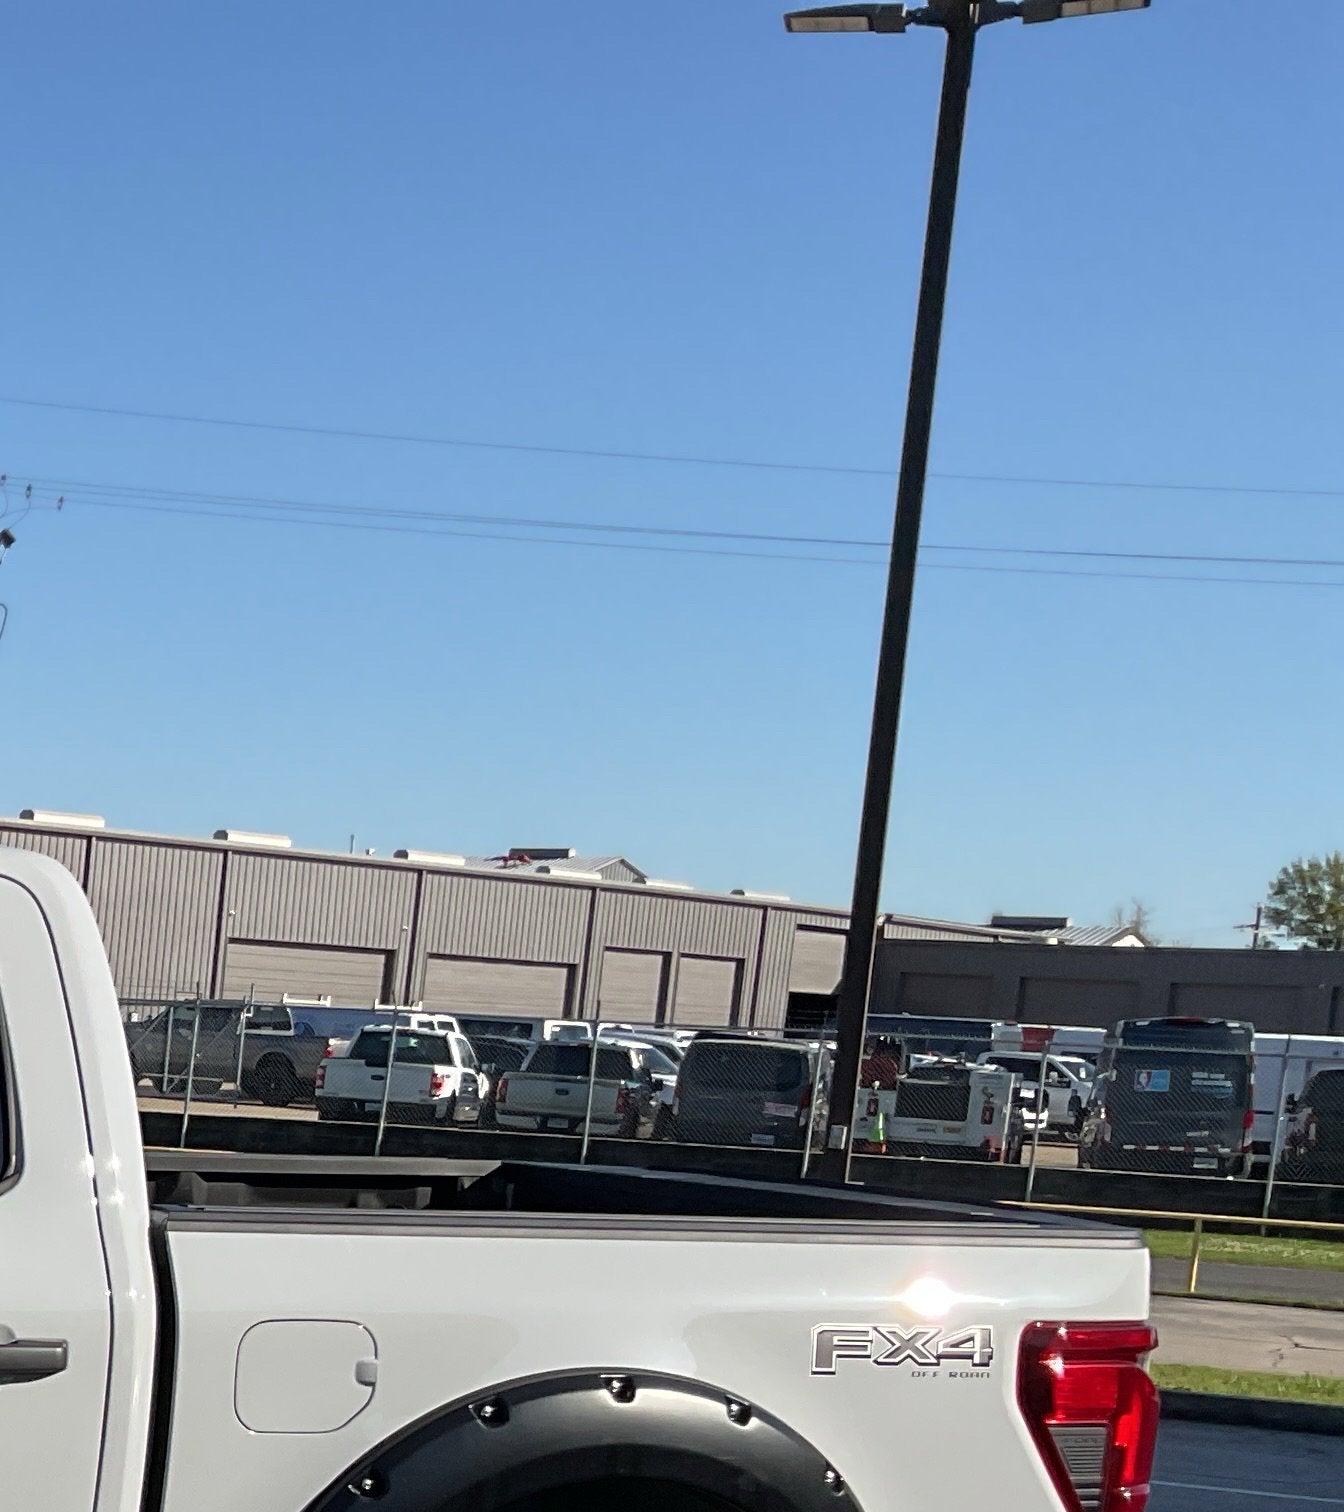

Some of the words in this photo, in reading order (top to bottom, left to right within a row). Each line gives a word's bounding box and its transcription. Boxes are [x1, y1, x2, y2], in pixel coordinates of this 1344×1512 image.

[810, 1322, 994, 1377] FX4
[911, 1370, 942, 1379] OFF
[948, 1370, 991, 1379] ROAD
